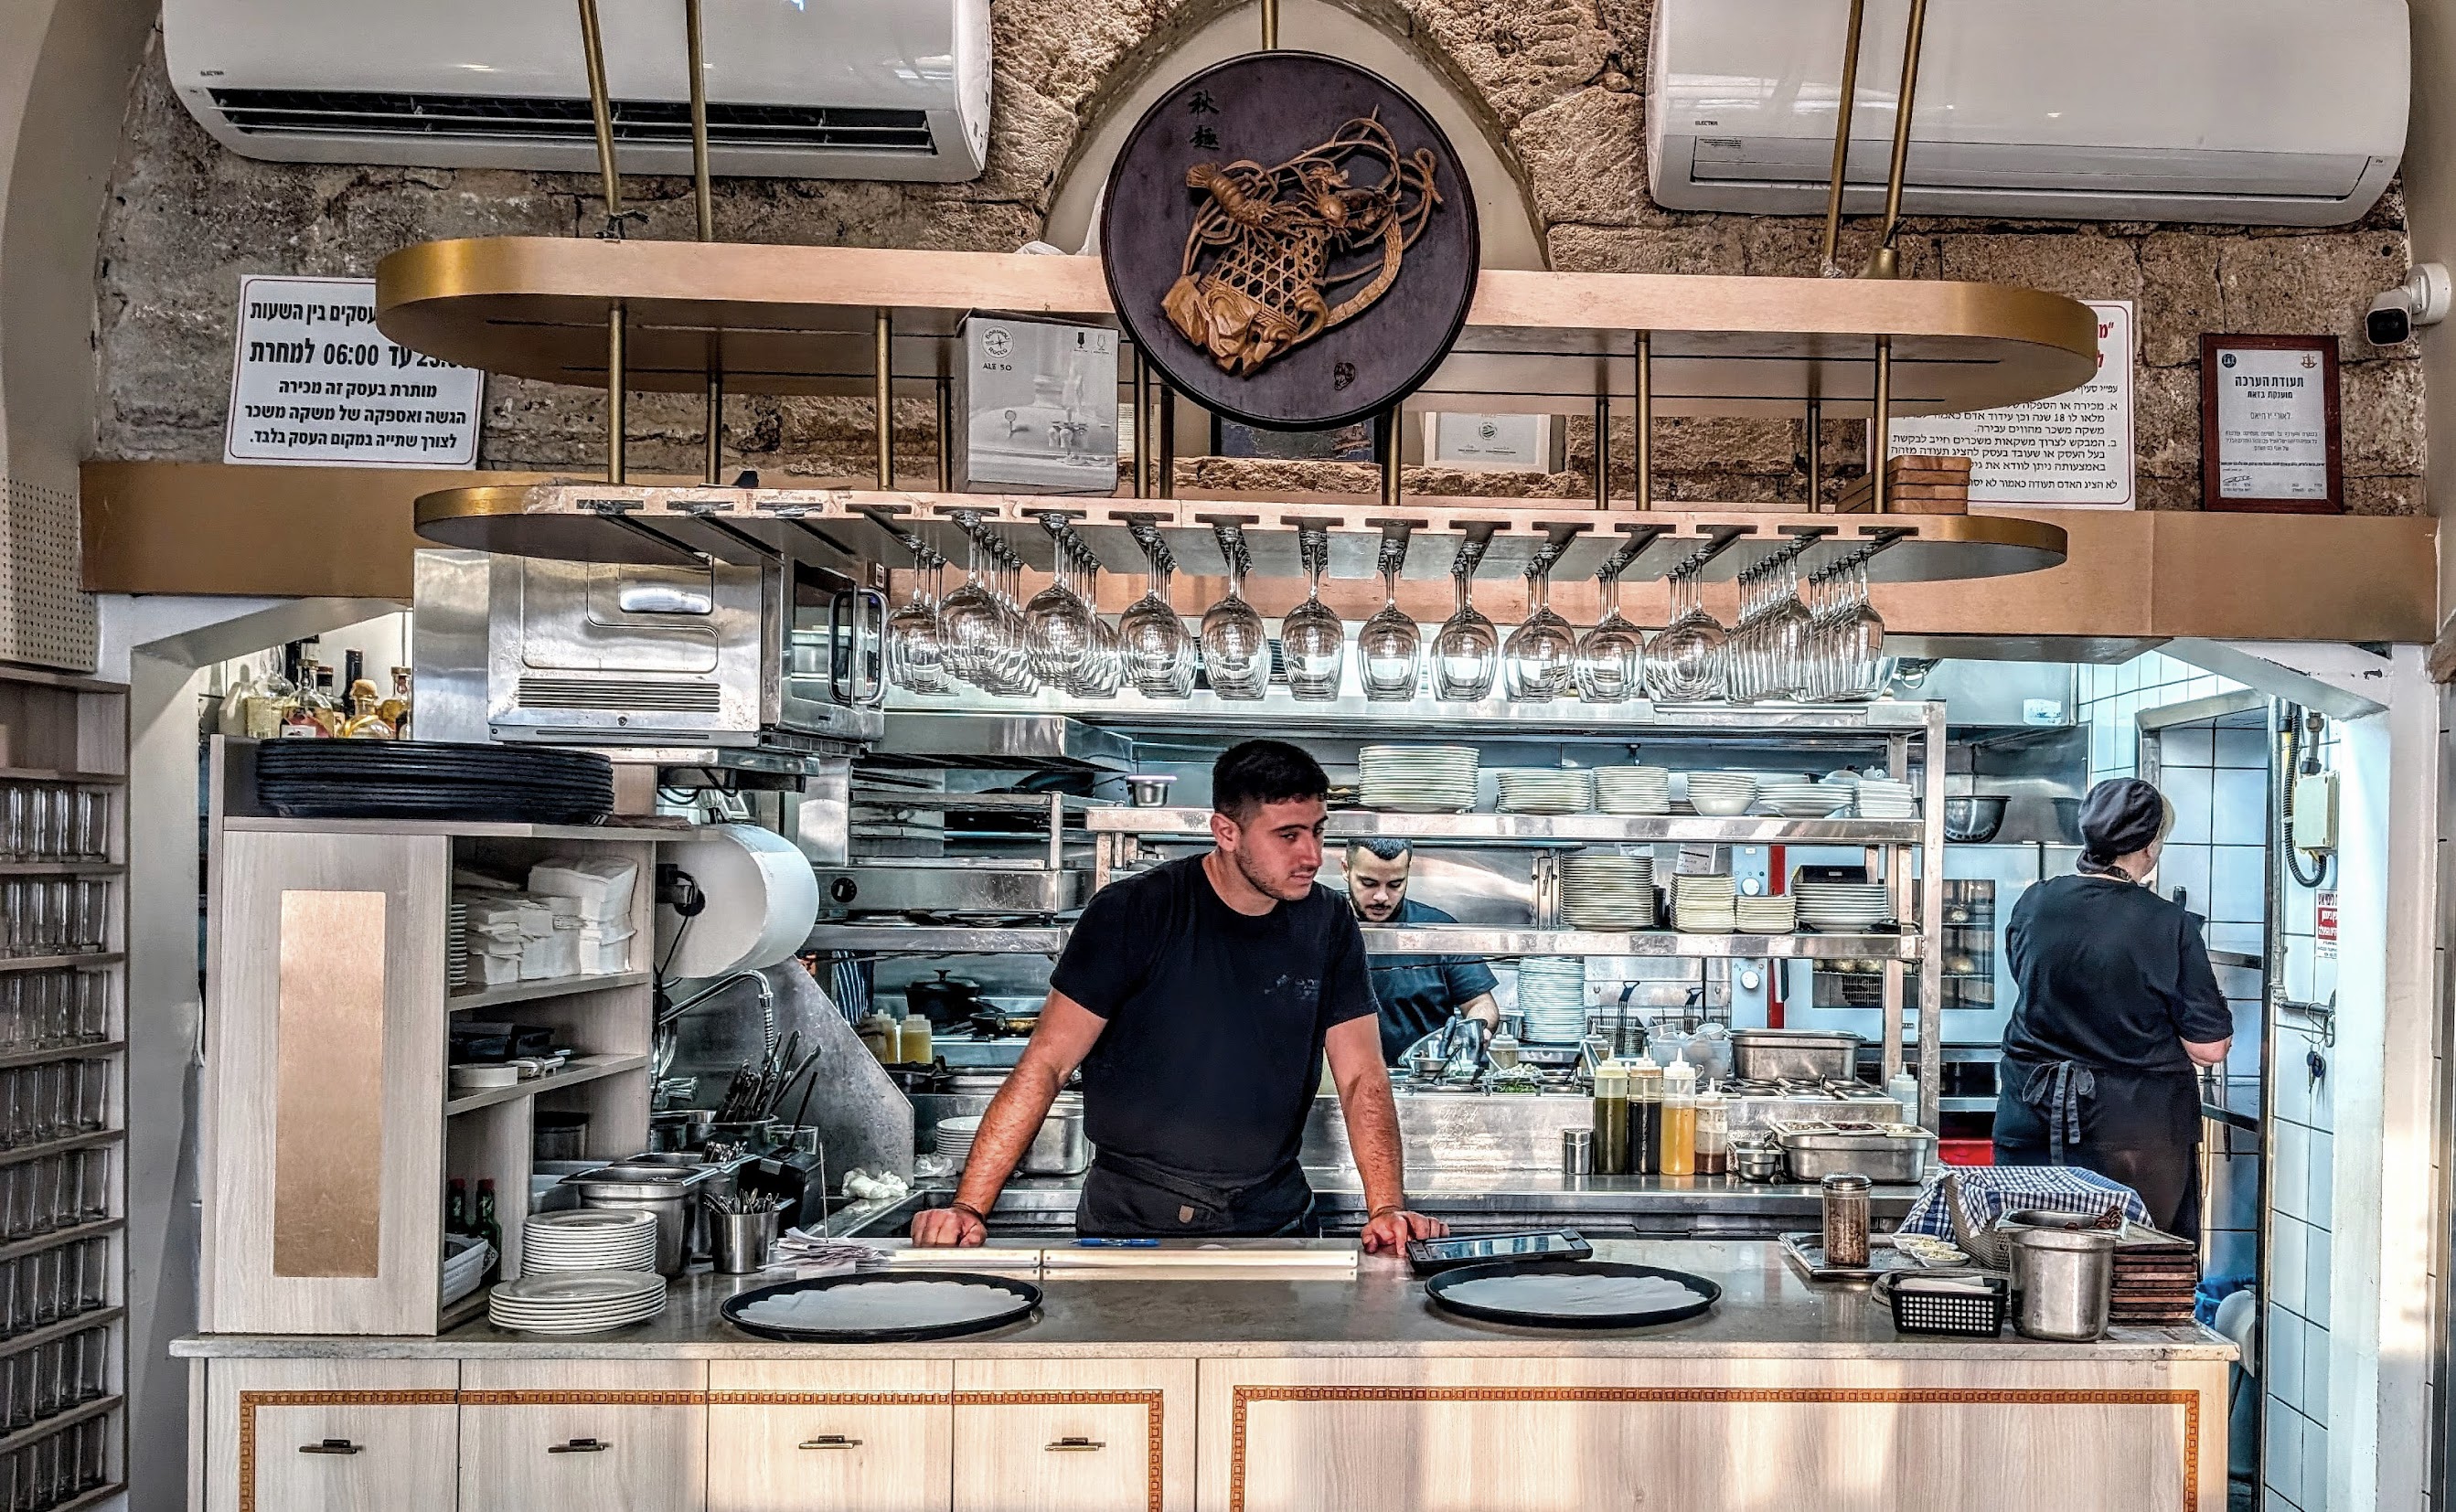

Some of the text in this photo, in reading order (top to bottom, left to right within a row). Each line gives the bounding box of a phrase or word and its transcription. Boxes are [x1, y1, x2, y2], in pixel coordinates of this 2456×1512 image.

[250, 302, 303, 321] השעות
[306, 303, 326, 325] בין
[249, 337, 315, 364] למחרת
[324, 343, 379, 366] 06:00
[389, 346, 412, 369] עד
[2235, 377, 2304, 388] תעודת הערכה
[279, 380, 437, 399] מותרת בעסק זה מכירה
[2078, 385, 2098, 395] סעיף
[2248, 390, 2293, 399] מוענקת בזאת
[2074, 402, 2104, 410] מכירה
[2107, 402, 2118, 410] א.
[245, 404, 466, 425] הגשה ואספקה של משקה משכר
[1964, 412, 1984, 421] אדם
[1988, 412, 2013, 421] עידוד
[2016, 413, 2030, 423] וכן
[2068, 413, 2077, 421] לו
[2080, 413, 2105, 421] מלאו
[2045, 426, 2072, 434] משכר
[2075, 427, 2105, 436] משקה
[250, 428, 457, 451] לצורך שתייה במקום העסק בלבד.
[1893, 434, 1927, 445] לבקשת
[1929, 435, 1950, 443] חייב
[1953, 437, 1991, 445] משכרים
[1994, 437, 2035, 447] משקאות
[2039, 438, 2066, 448] לצרוך
[2069, 439, 2105, 449] המבקש
[1891, 446, 1917, 454] מזהה
[1919, 447, 1949, 456] תעודה
[1952, 447, 1979, 456] להציג
[1981, 449, 2008, 458] בעסק
[2012, 450, 2041, 458] שעובד
[2088, 449, 2105, 459] בעל
[2057, 451, 2085, 460] העסק
[1985, 462, 2000, 470] את
[2003, 461, 2030, 470] לוודא
[2033, 462, 2052, 472] ניתן
[2055, 463, 2106, 471] באמצעותה
[1985, 478, 1997, 487] לא
[2000, 479, 2026, 488] כאמור
[2028, 480, 2055, 488] תעודה
[2057, 481, 2082, 489] האדם
[2084, 481, 2104, 489] הציג
[2106, 479, 2118, 489] לא
